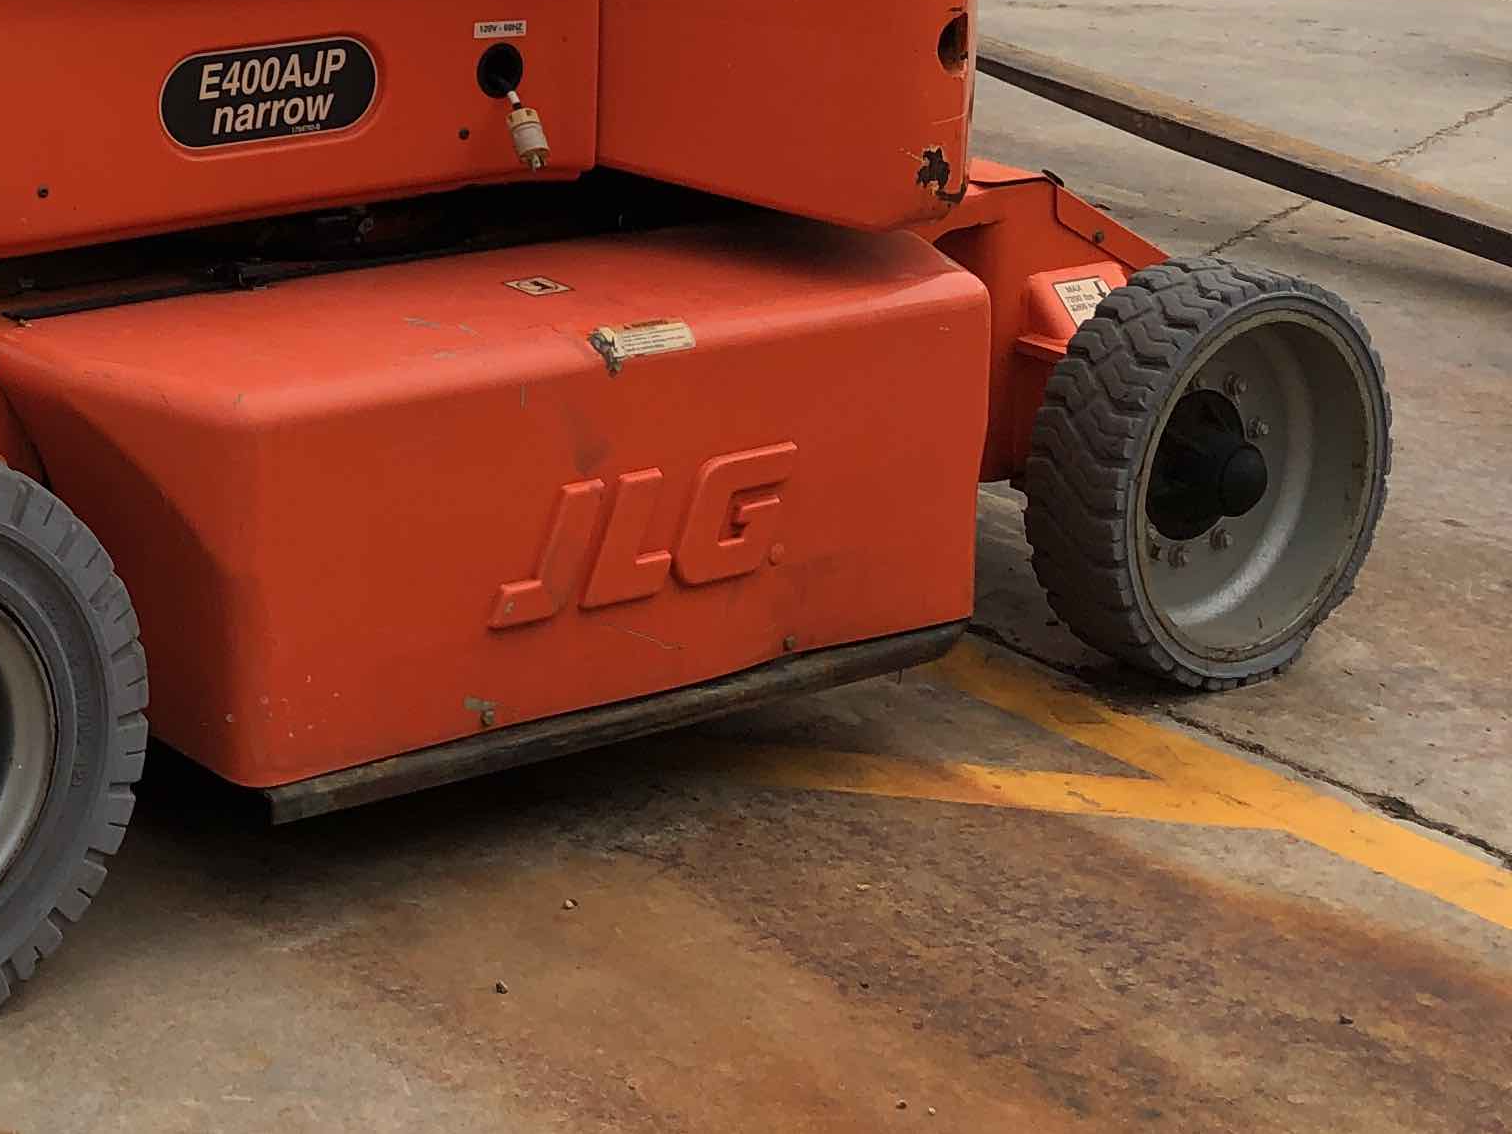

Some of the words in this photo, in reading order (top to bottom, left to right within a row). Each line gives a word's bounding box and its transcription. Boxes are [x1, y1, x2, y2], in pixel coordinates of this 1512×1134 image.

[198, 48, 347, 101] E400AJP
[211, 92, 334, 135] narrow
[488, 440, 798, 629] JLG
